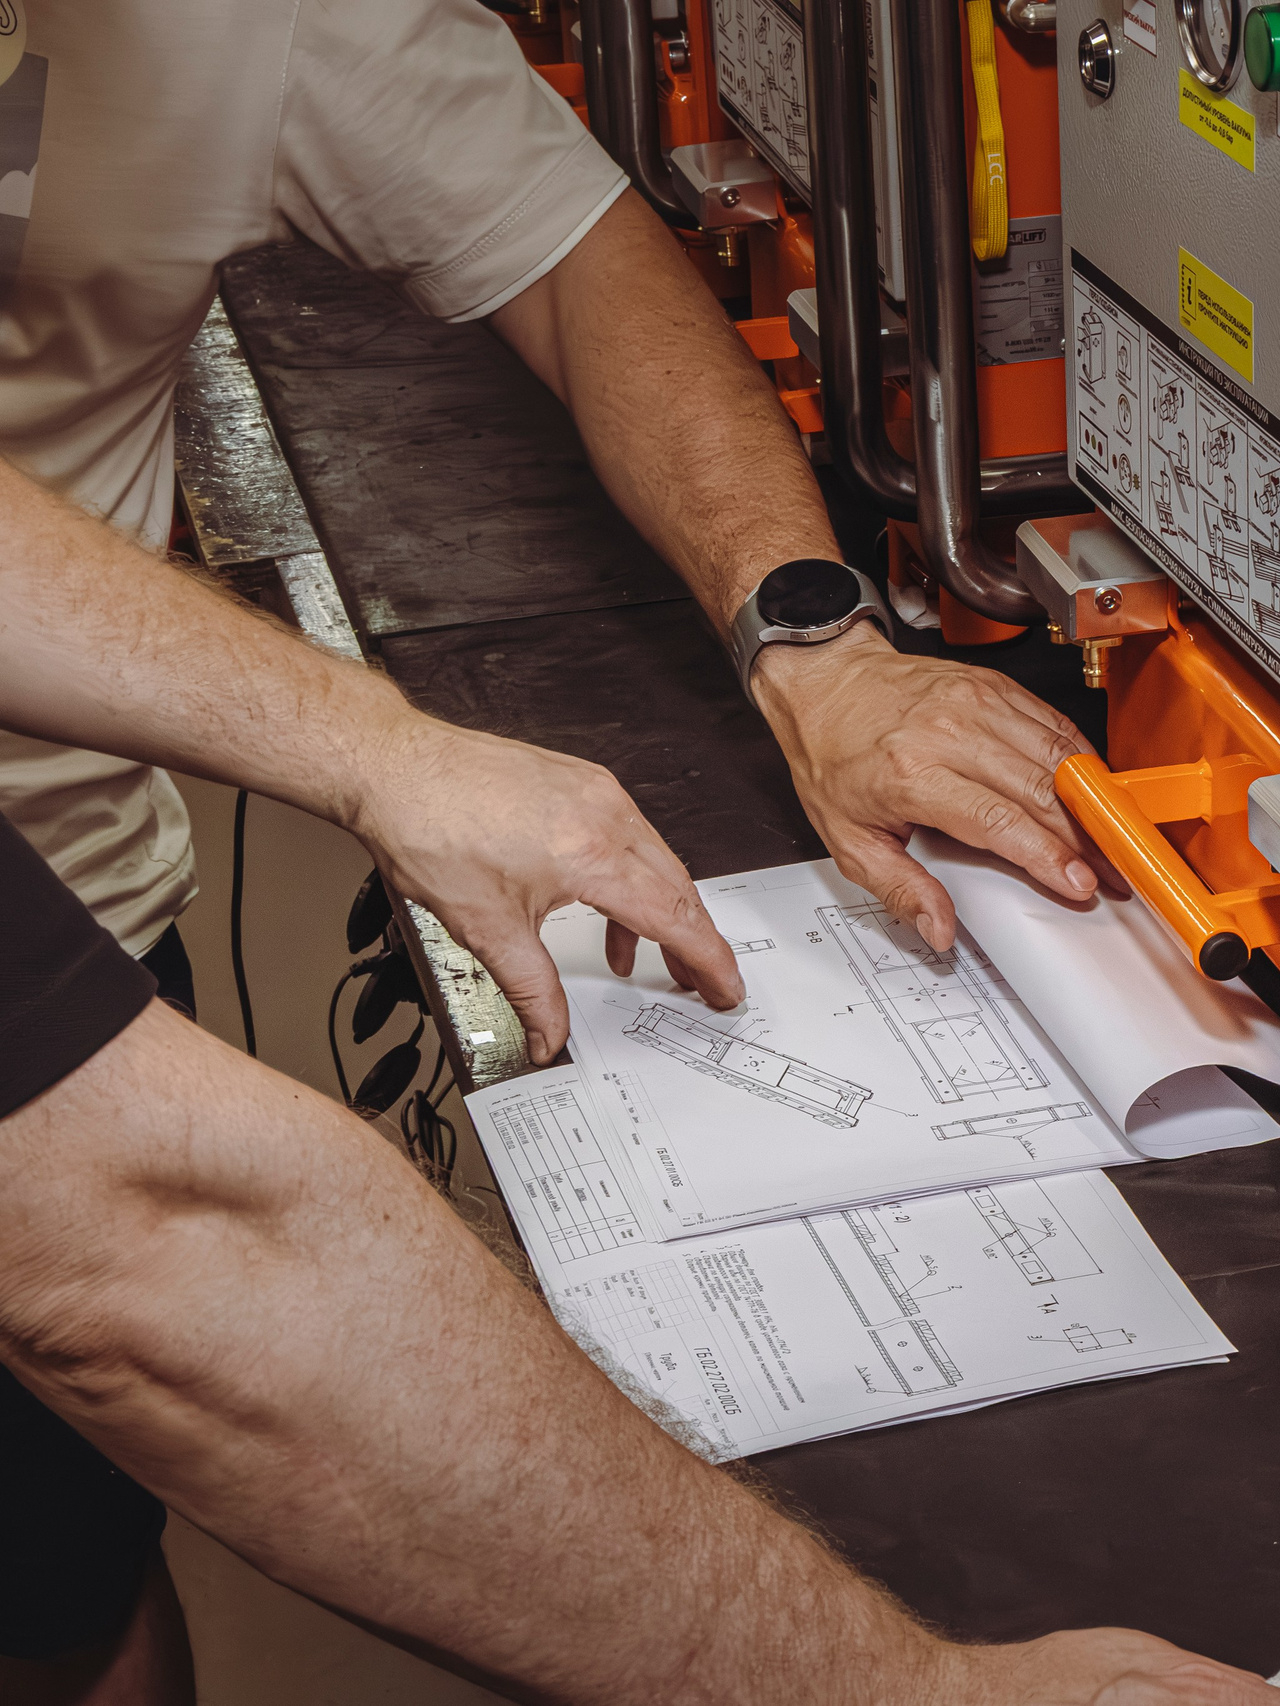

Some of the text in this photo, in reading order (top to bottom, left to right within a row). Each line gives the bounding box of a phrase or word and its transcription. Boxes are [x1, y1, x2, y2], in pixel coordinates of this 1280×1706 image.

[1178, 339, 1214, 382] ИНСТРУКЦИЯ
[1223, 377, 1268, 427] ЭКСПЛУАТАЦИИ
[806, 930, 823, 944] В-В
[656, 1147, 684, 1188] ГБ.02.27.01.00СБ
[658, 1351, 680, 1372] Труба
[694, 1347, 742, 1416] ГБ.02.27.02.00СБ
